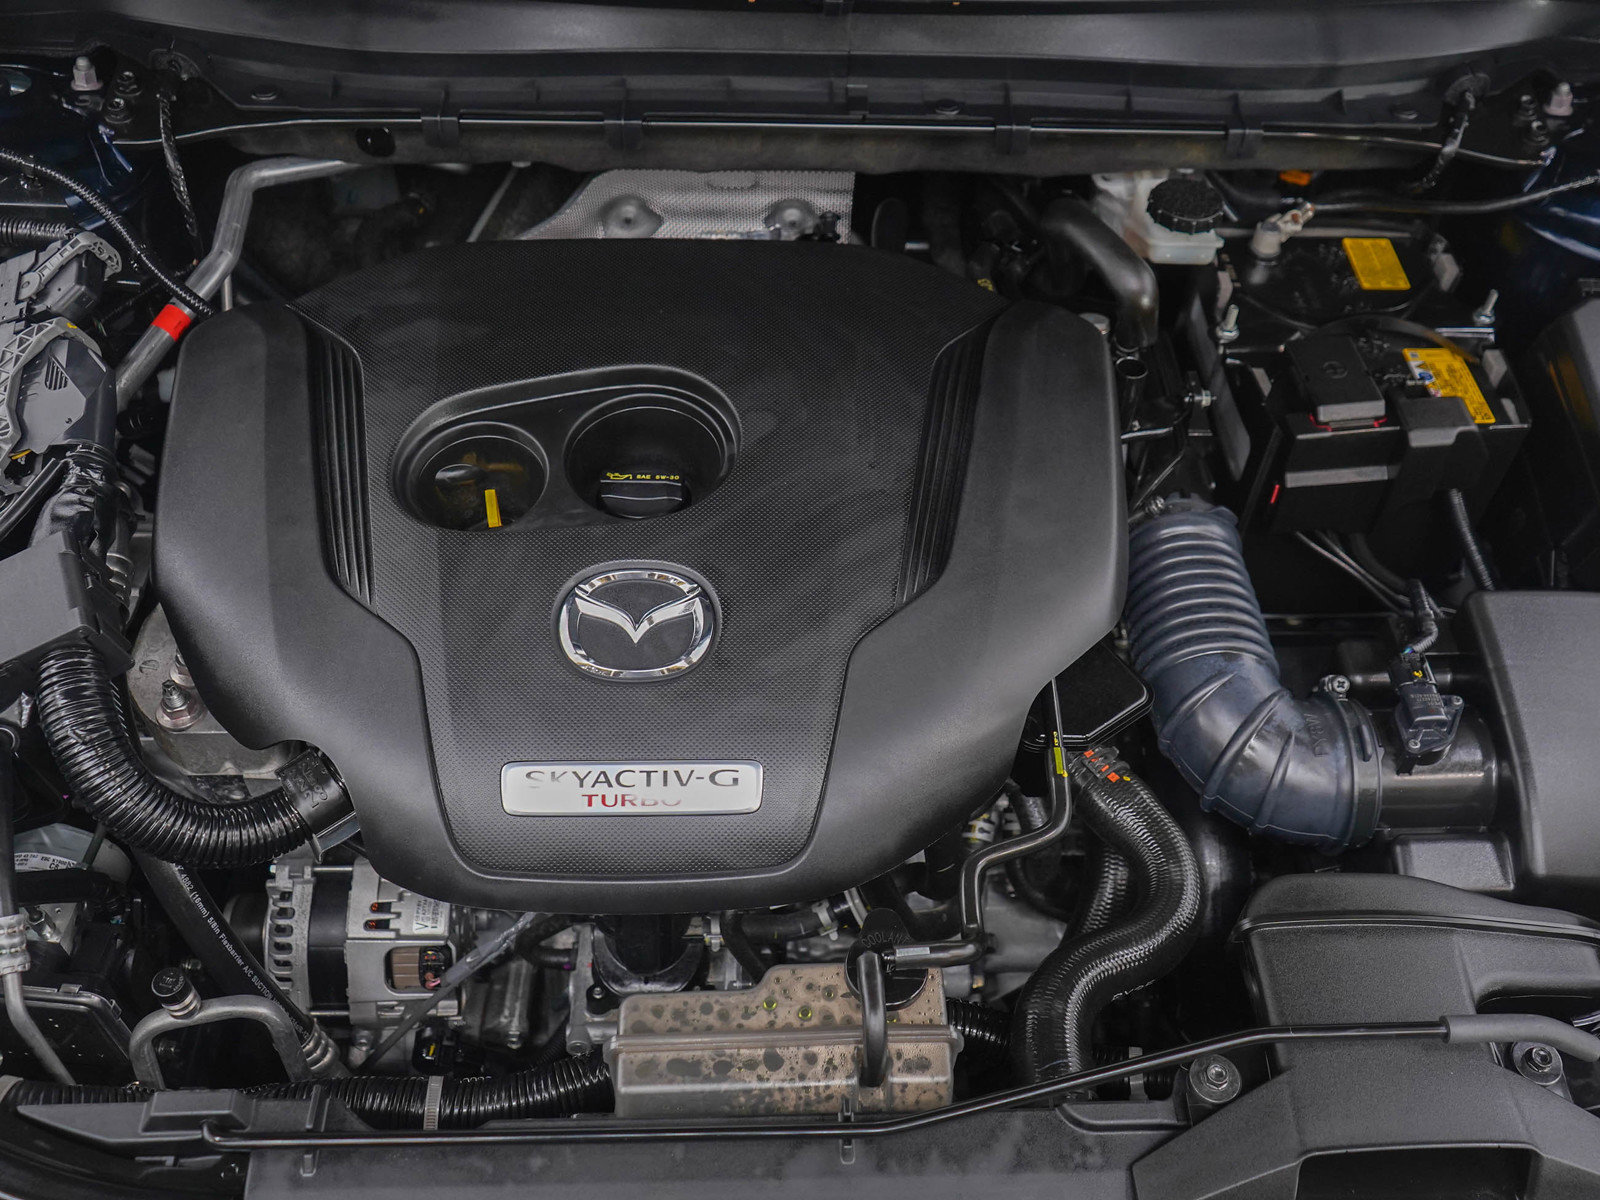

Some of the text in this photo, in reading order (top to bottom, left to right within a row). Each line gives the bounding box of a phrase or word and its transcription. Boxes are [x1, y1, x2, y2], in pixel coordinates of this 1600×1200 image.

[525, 769, 740, 789] SKYACTIV-G
[581, 794, 683, 808] TURBO
[189, 891, 210, 918] (16mm)
[207, 916, 220, 935] 5/8in
[219, 932, 245, 967] Flexbarrier
[243, 965, 254, 977] A/C
[252, 975, 274, 1000] SUCTION
[861, 931, 911, 948] COOLANT
